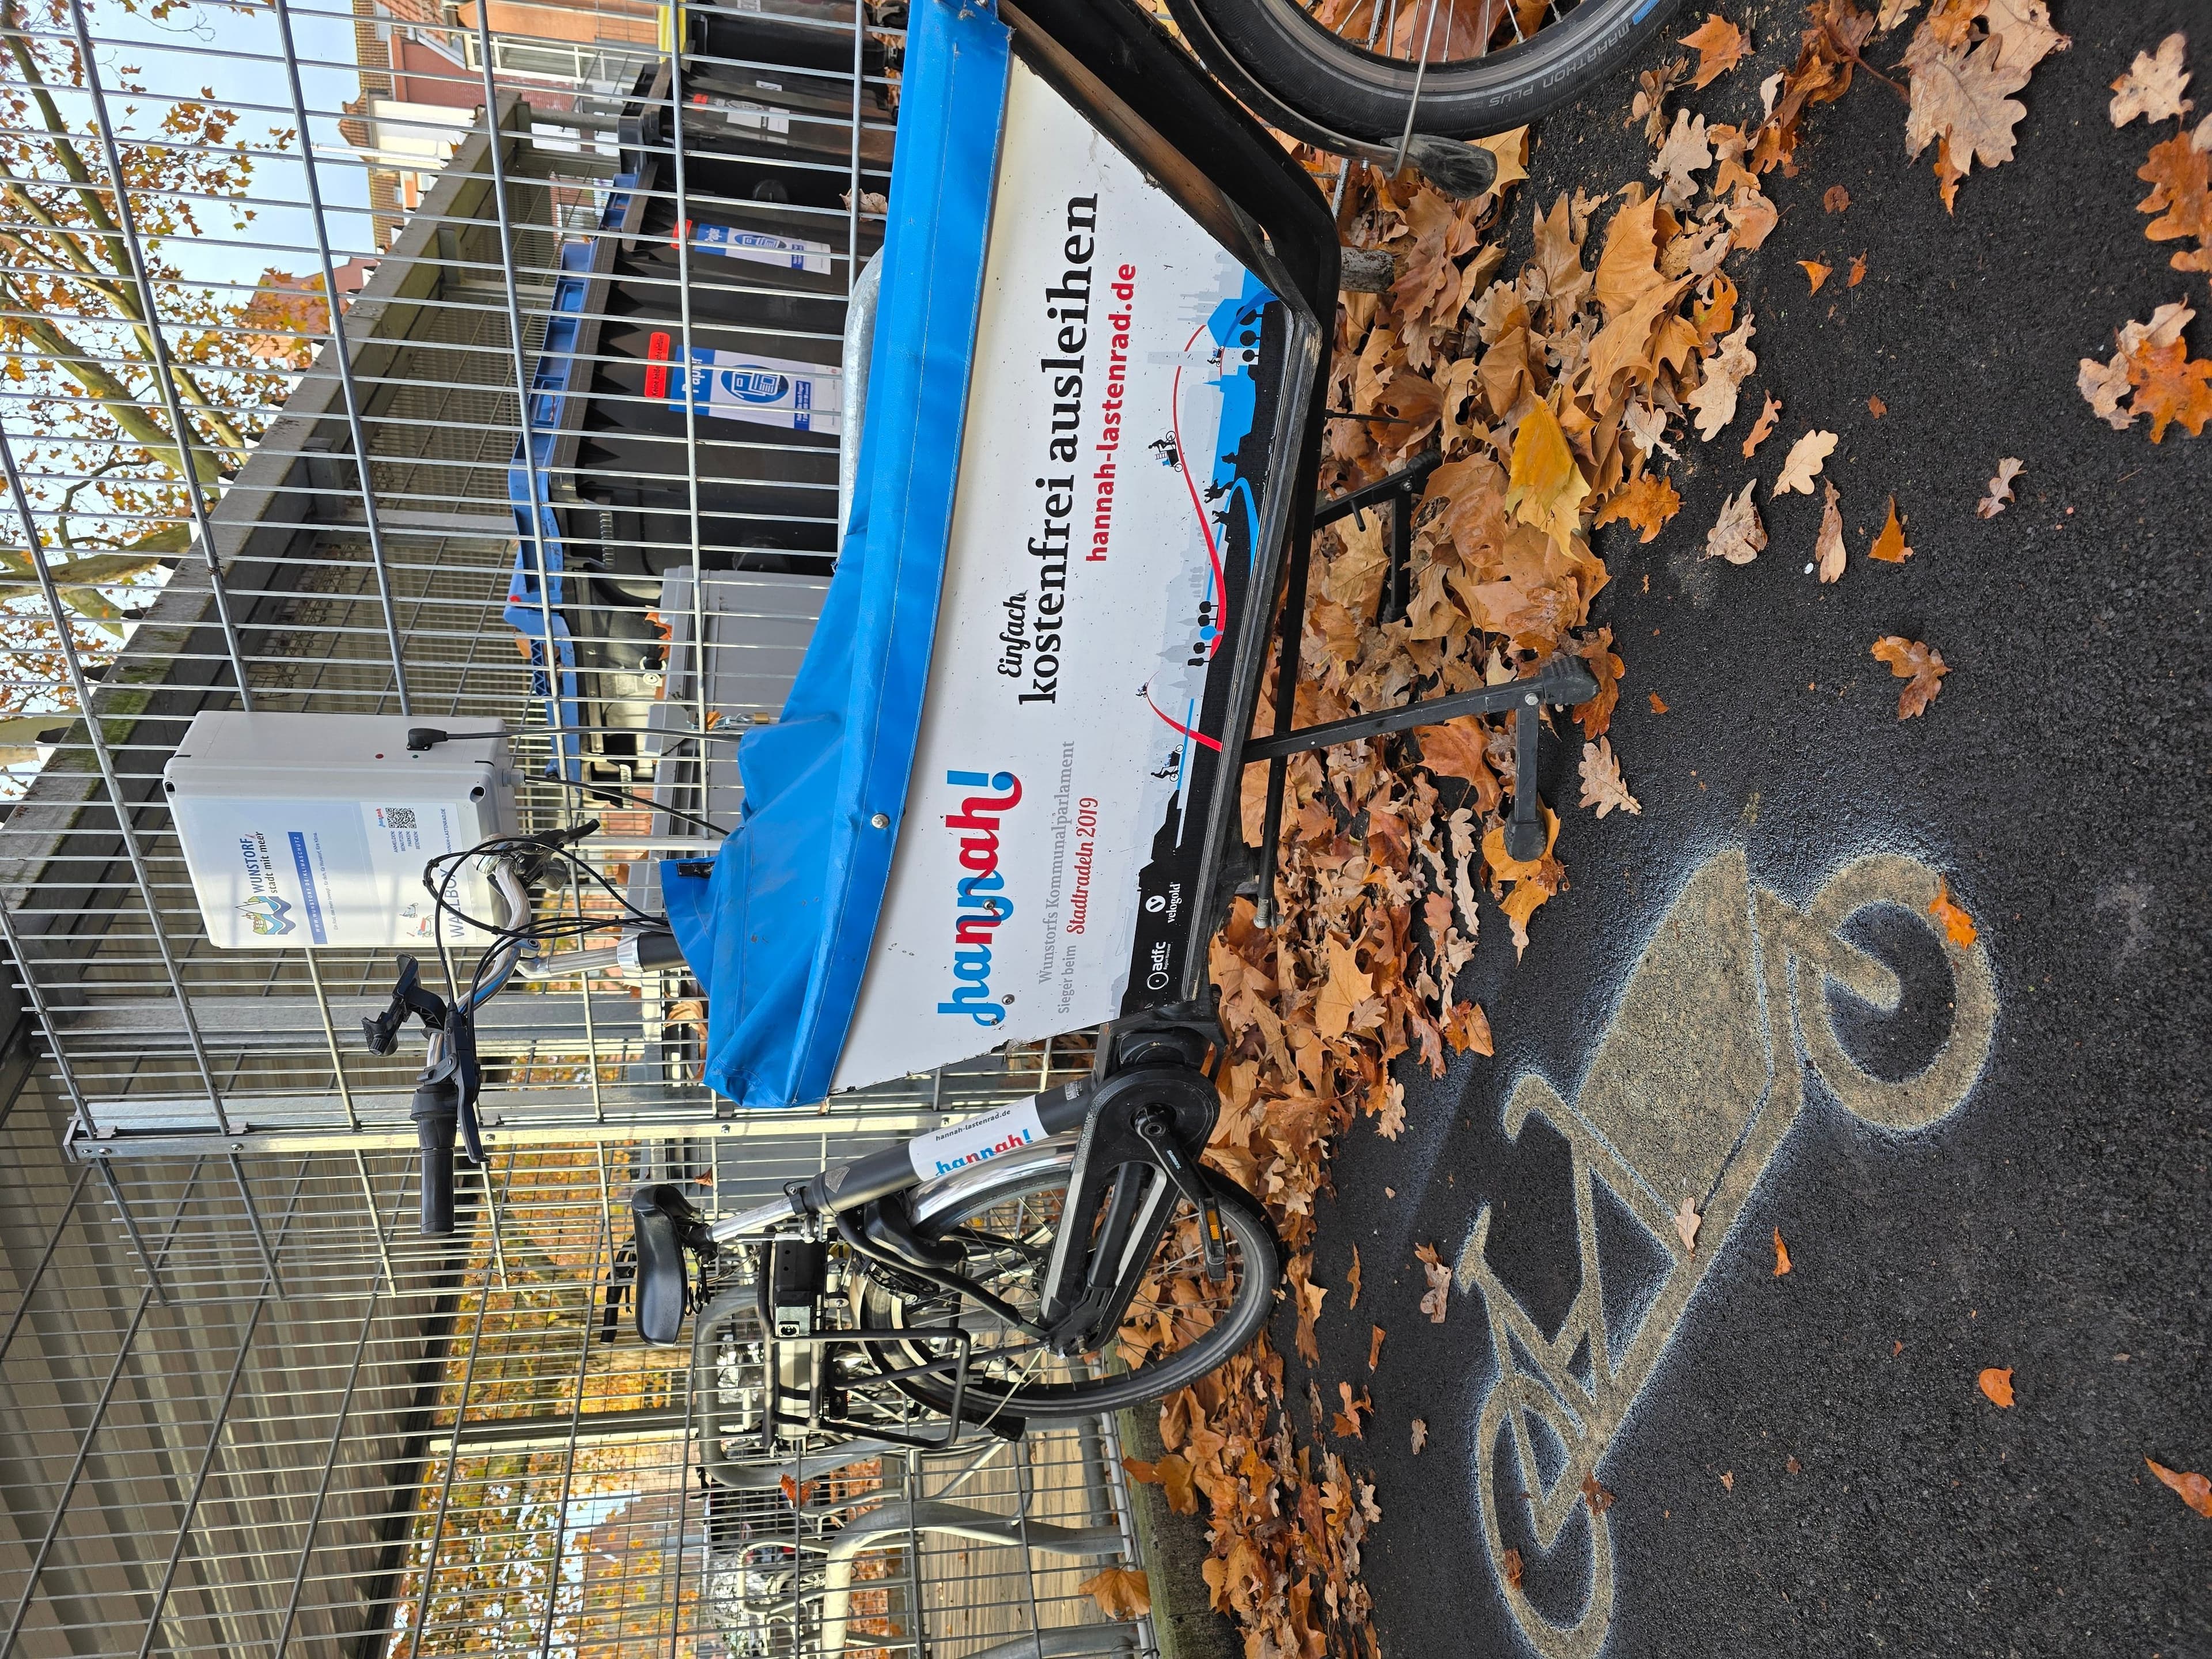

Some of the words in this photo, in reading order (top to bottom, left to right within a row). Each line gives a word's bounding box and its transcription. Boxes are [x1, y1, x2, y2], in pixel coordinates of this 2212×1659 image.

[1488, 84, 1535, 105] PLUS
[1041, 193, 1098, 463] ausleihen
[1085, 264, 1136, 562] hannah-lastenrad.de
[1018, 475, 1074, 705] kostenfrei
[997, 592, 1031, 678] Einfach
[1046, 741, 1075, 909] Kommunalparlament
[1076, 797, 1098, 838] 2019
[255, 831, 267, 853] meer
[260, 856, 272, 870] mit
[240, 839, 265, 893] WUNSTORF
[264, 873, 278, 893] stadt
[1067, 841, 1094, 934] Stadtradeln
[937, 770, 1022, 1026] hannah!
[1038, 911, 1058, 984] Wunstorfs
[1062, 945, 1077, 975] beim
[1151, 941, 1166, 971] adfc
[1058, 978, 1075, 1014] Sieger
[935, 1110, 1010, 1142] hannah-lastenrad.de
[935, 1129, 1033, 1176] hannah!
